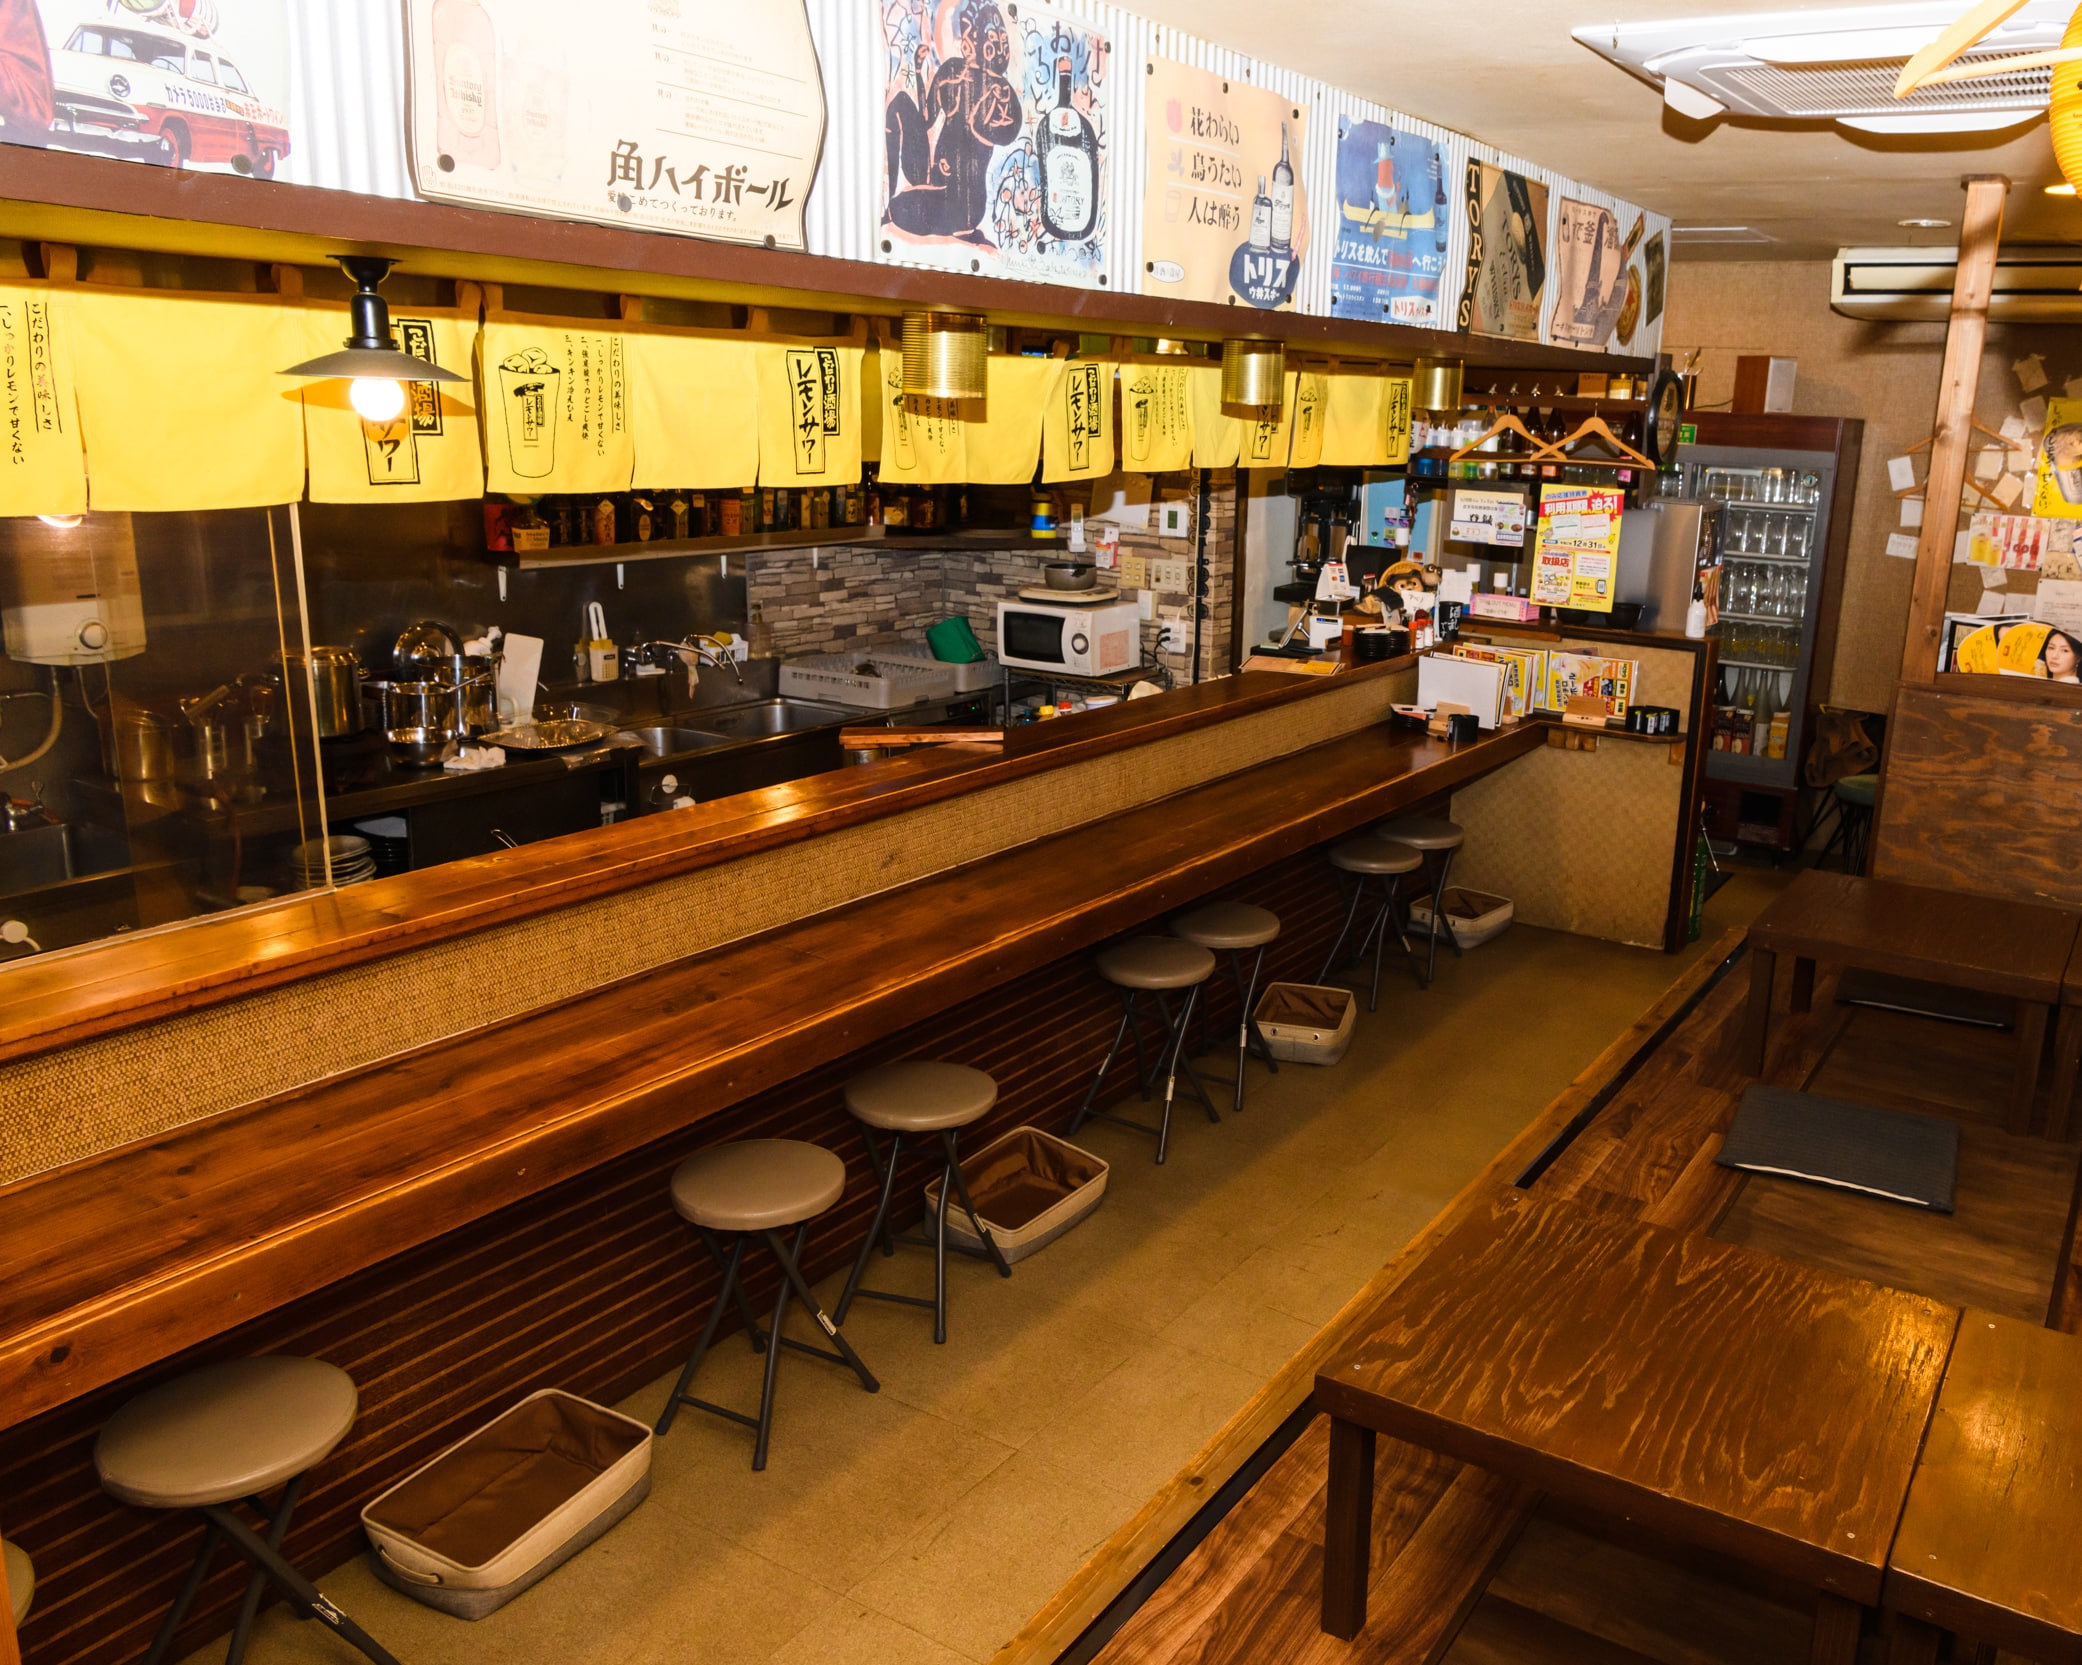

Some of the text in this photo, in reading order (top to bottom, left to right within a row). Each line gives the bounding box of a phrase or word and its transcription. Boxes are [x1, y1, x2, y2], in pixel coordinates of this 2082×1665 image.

[1190, 105, 1240, 145] 花わらい
[606, 138, 795, 212] 角ハイボール
[1191, 152, 1243, 188] 鳥うたい
[1187, 196, 1241, 231] 人は酔う
[1459, 163, 1483, 328] TORYS
[1243, 254, 1290, 289] トリス
[31, 302, 53, 431] こだわりの美味しさ
[407, 327, 436, 428] こだ酒場
[613, 336, 623, 432] こだわりの美味しさ
[819, 352, 838, 430] こだわり酒場
[795, 358, 821, 466] レモンサワー
[1070, 374, 1086, 463] レモンサワー
